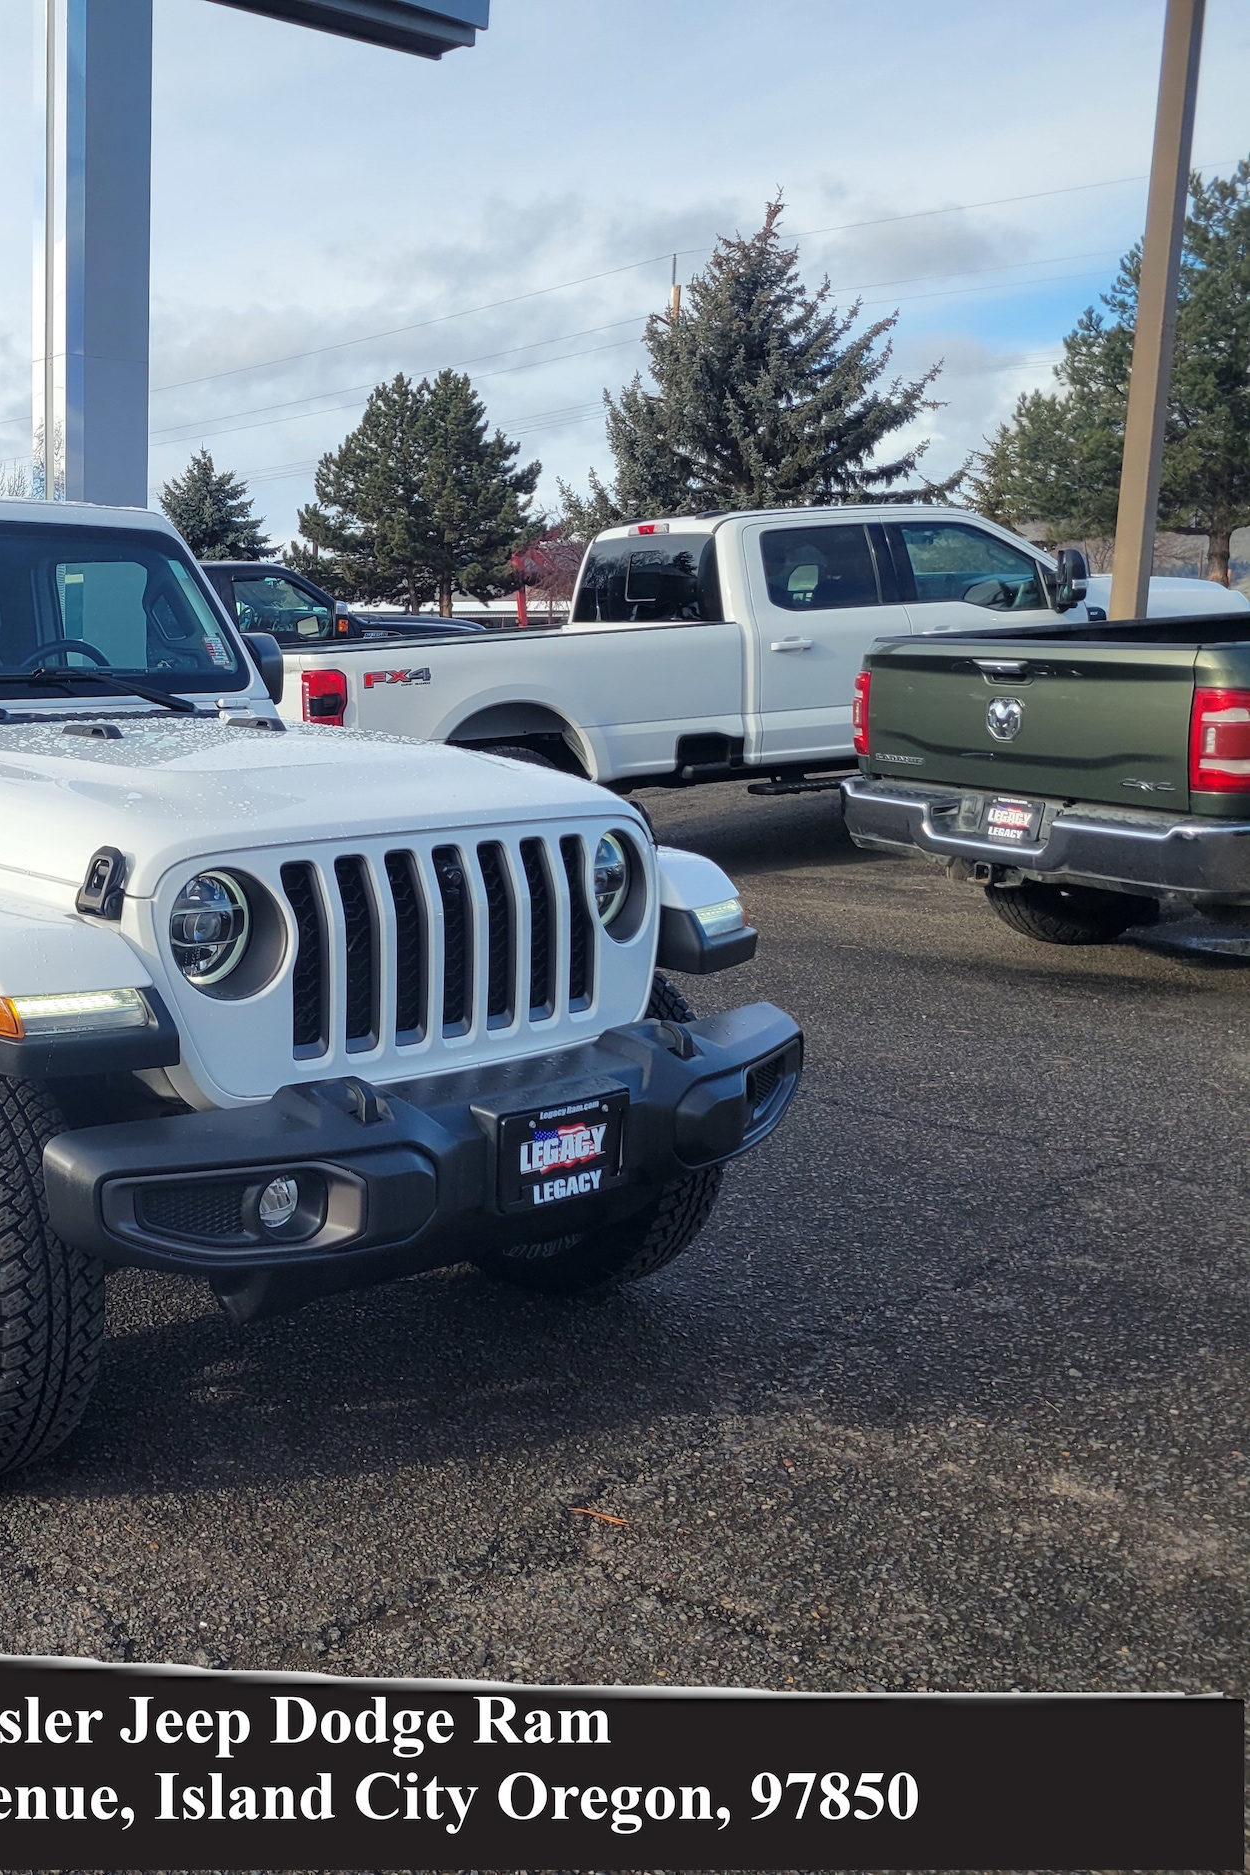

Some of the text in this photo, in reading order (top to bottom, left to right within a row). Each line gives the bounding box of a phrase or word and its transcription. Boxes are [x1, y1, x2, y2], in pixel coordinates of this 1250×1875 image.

[364, 668, 431, 689] FX4
[988, 807, 1032, 827] LEGACY
[988, 826, 1023, 839] LEGACY
[520, 1125, 607, 1173] LEGACY
[533, 1169, 602, 1205] LEGACY
